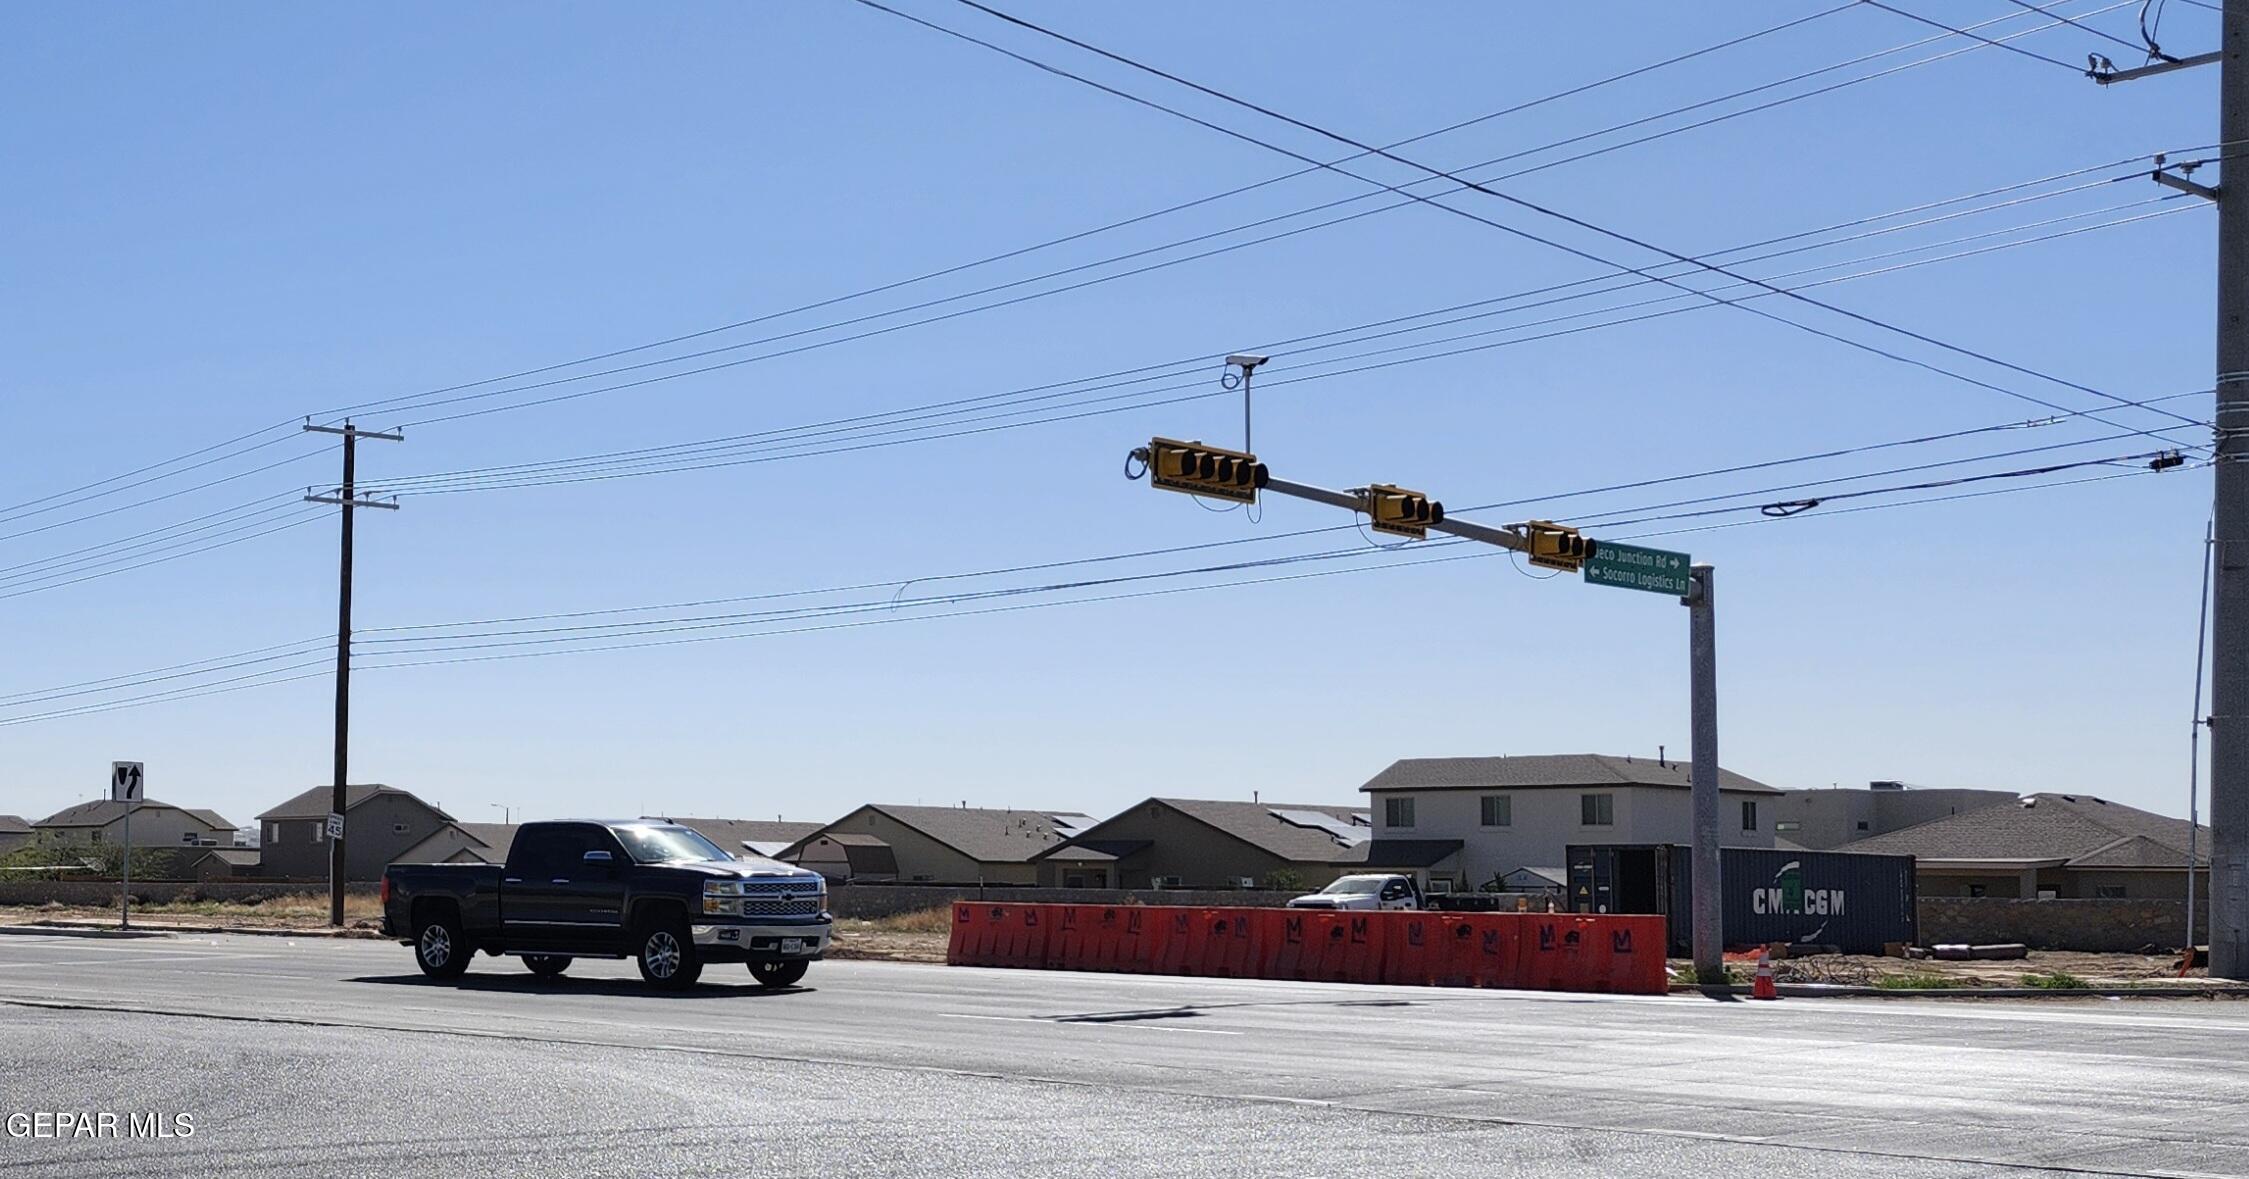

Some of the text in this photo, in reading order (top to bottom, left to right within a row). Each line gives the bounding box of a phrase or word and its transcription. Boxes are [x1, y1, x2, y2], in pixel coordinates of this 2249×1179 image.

[1595, 547, 1667, 569] eco Junction Rd
[1602, 566, 1686, 590] Socorro Logistics Ln
[328, 825, 341, 836] 45
[1753, 888, 1844, 915] CM CGM
